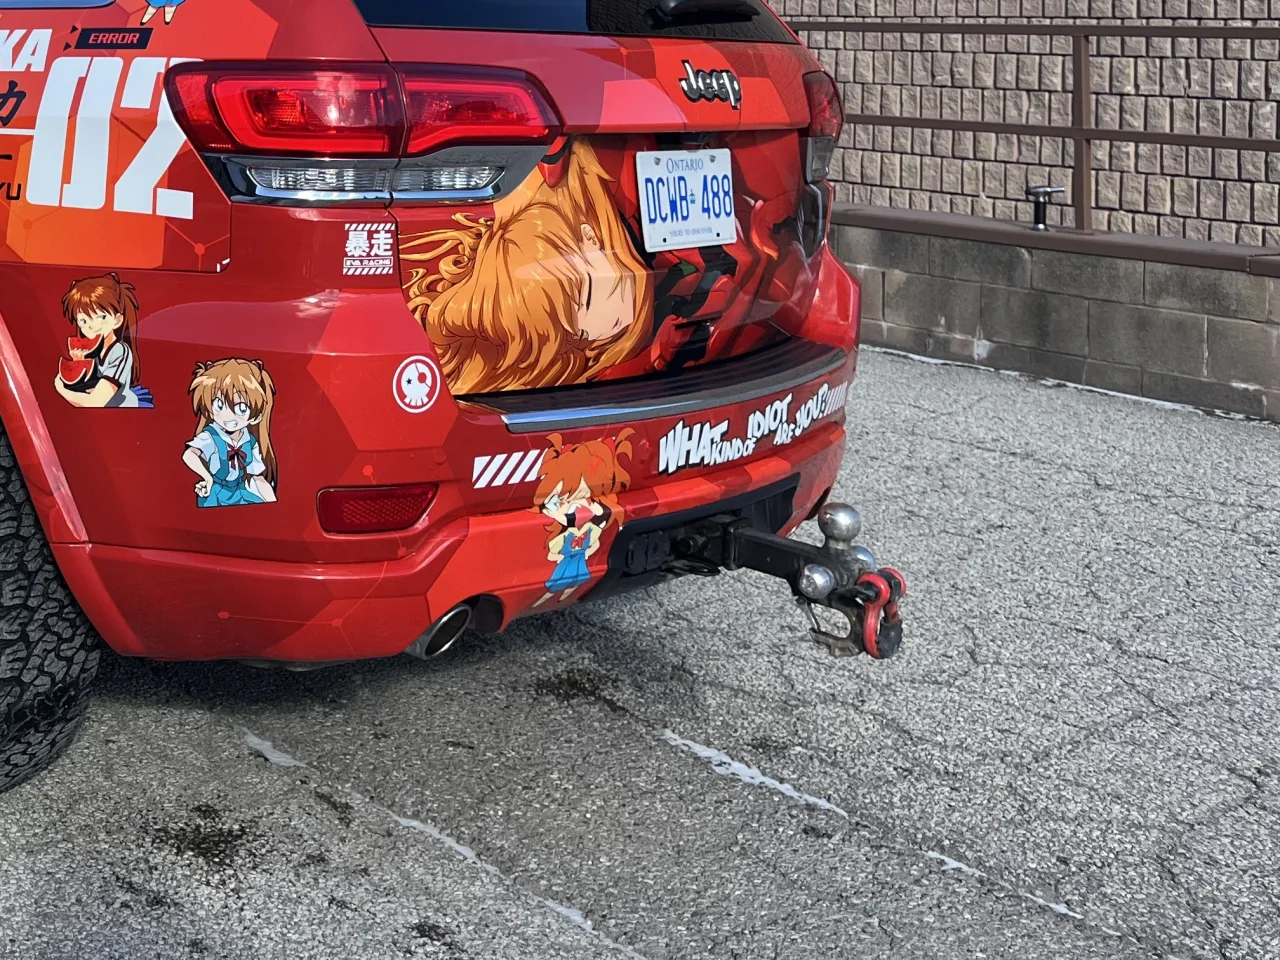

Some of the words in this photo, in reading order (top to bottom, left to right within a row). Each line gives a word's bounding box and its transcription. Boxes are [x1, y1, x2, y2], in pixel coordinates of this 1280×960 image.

[87, 32, 140, 45] ERROR
[679, 59, 742, 110] Jeep
[26, 56, 205, 220] 02
[644, 175, 690, 224] DCWB
[701, 173, 733, 220] 488
[345, 230, 393, 257] 暴走
[362, 258, 391, 266] RACING
[747, 393, 793, 438] IDIOT
[659, 419, 729, 474] WHAT
[742, 437, 757, 458] OF
[773, 422, 796, 445] ARE
[710, 438, 744, 466] KIND
